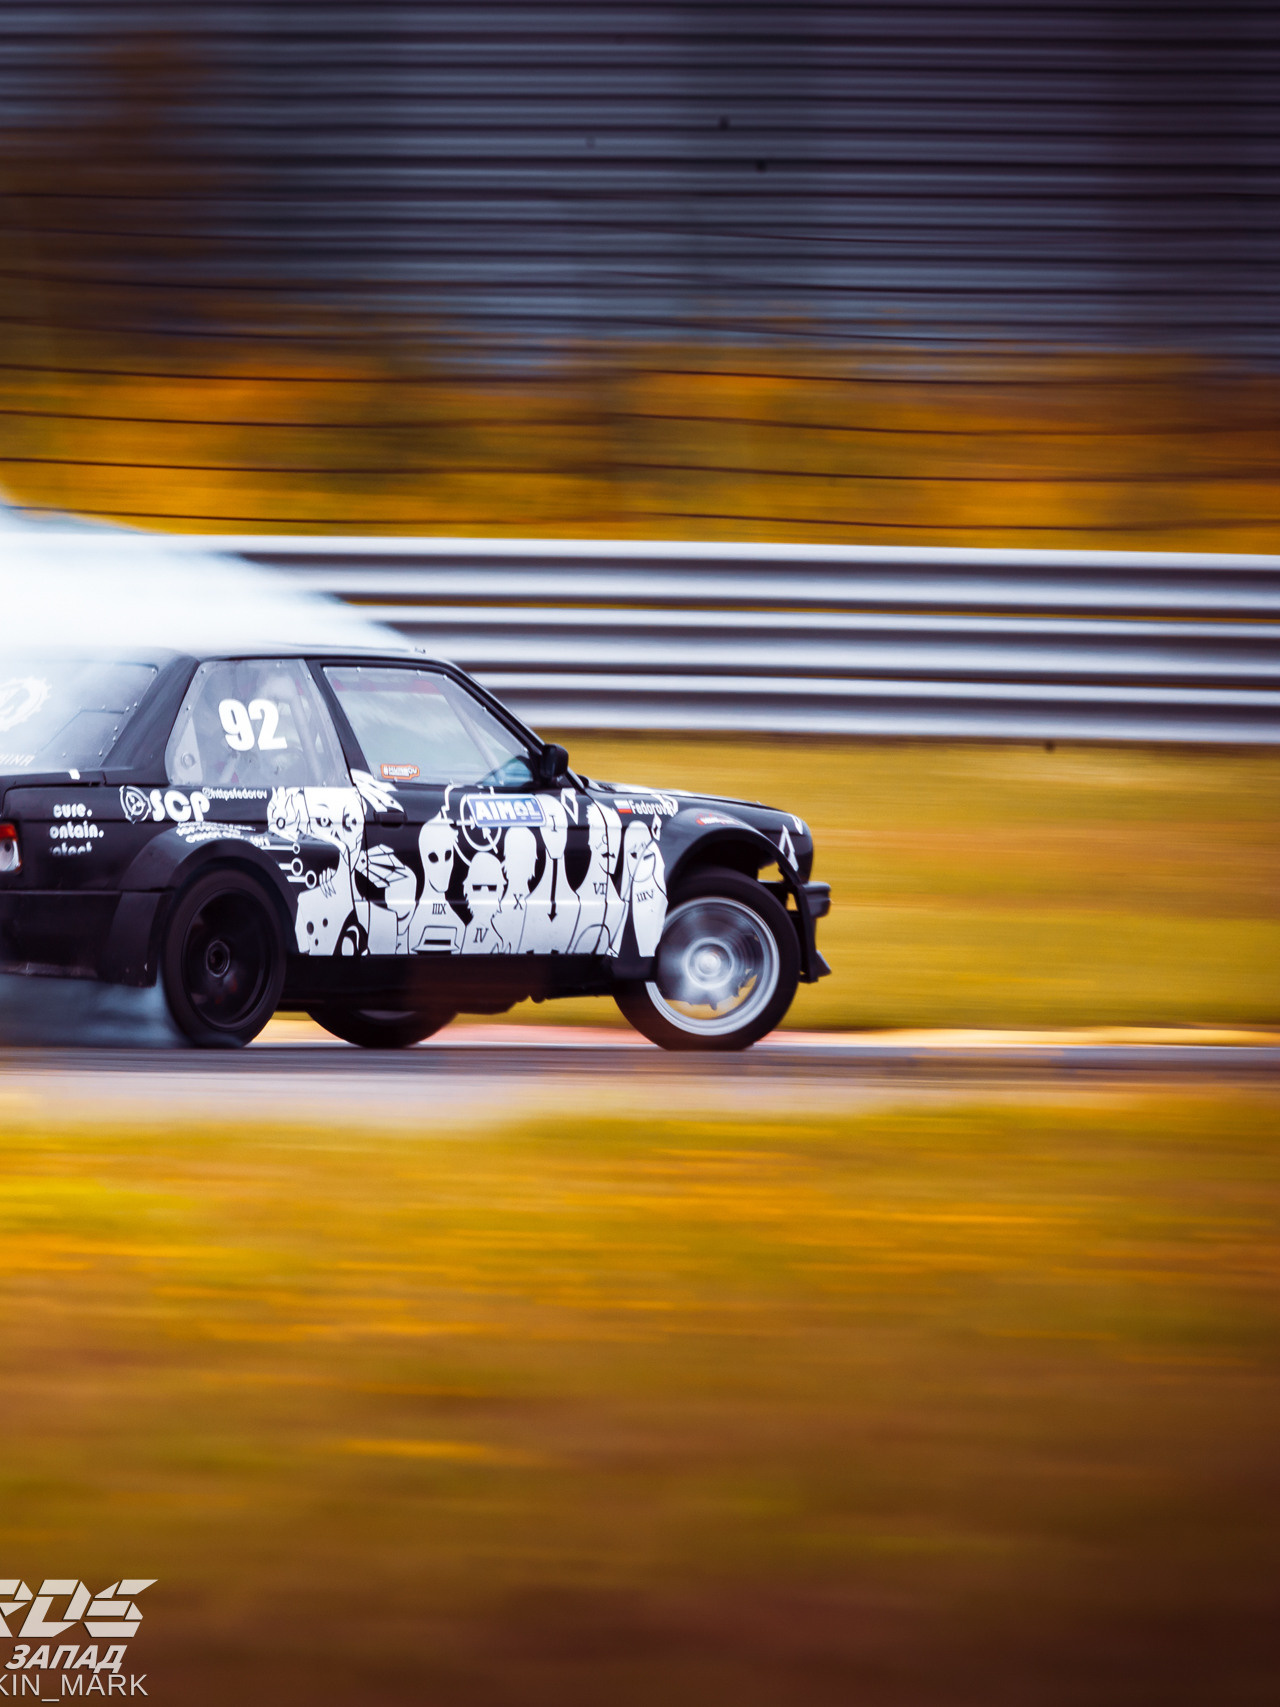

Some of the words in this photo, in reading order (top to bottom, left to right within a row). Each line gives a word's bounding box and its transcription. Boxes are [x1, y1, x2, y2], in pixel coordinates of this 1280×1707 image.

[218, 699, 288, 751] 92
[149, 789, 211, 822] SCP
[474, 800, 543, 821] AIMOL
